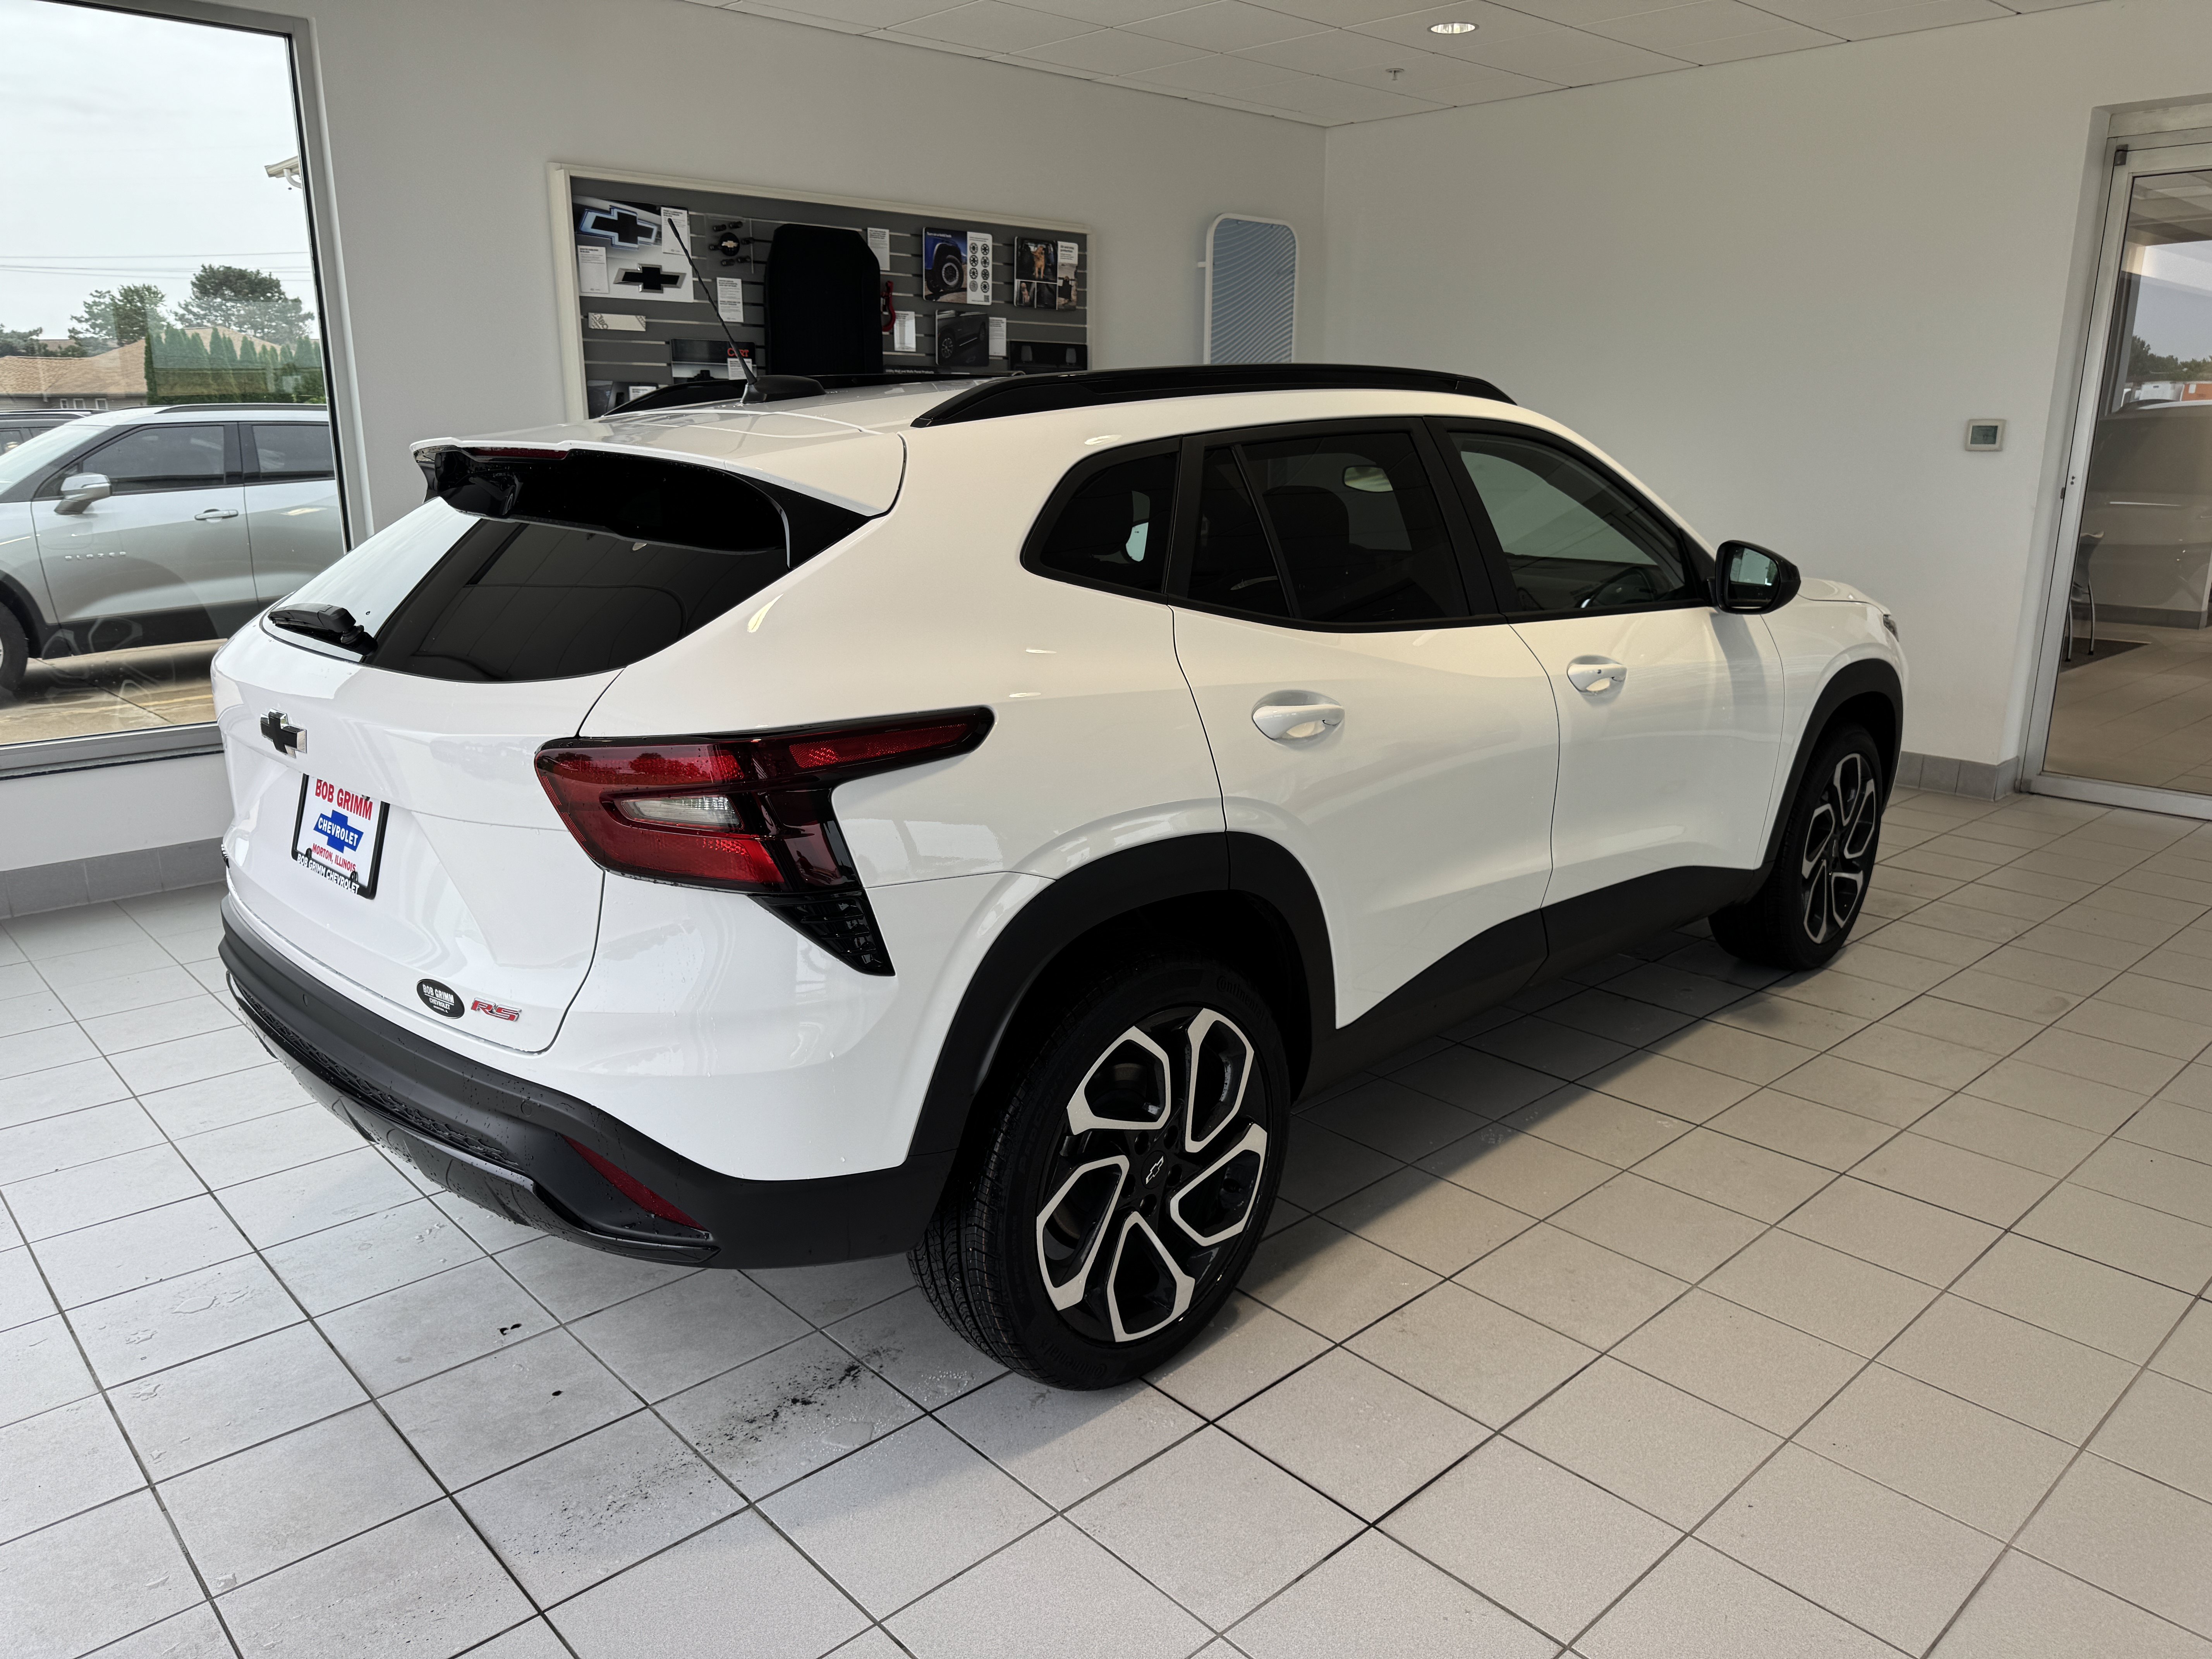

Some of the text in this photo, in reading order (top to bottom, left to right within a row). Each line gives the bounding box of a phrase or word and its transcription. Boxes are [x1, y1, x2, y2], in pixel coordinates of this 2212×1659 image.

[727, 347, 749, 357] CRT
[315, 778, 373, 821] BOB GRIMM
[318, 817, 359, 847] CHEVROLET
[312, 843, 356, 872] MORTON, ILLINOIS
[297, 853, 360, 894] BOB GRIMM CHEVROLET
[422, 984, 455, 1004] BOB GRIMM
[429, 997, 450, 1010] CHEVROLET
[471, 997, 522, 1022] RS
